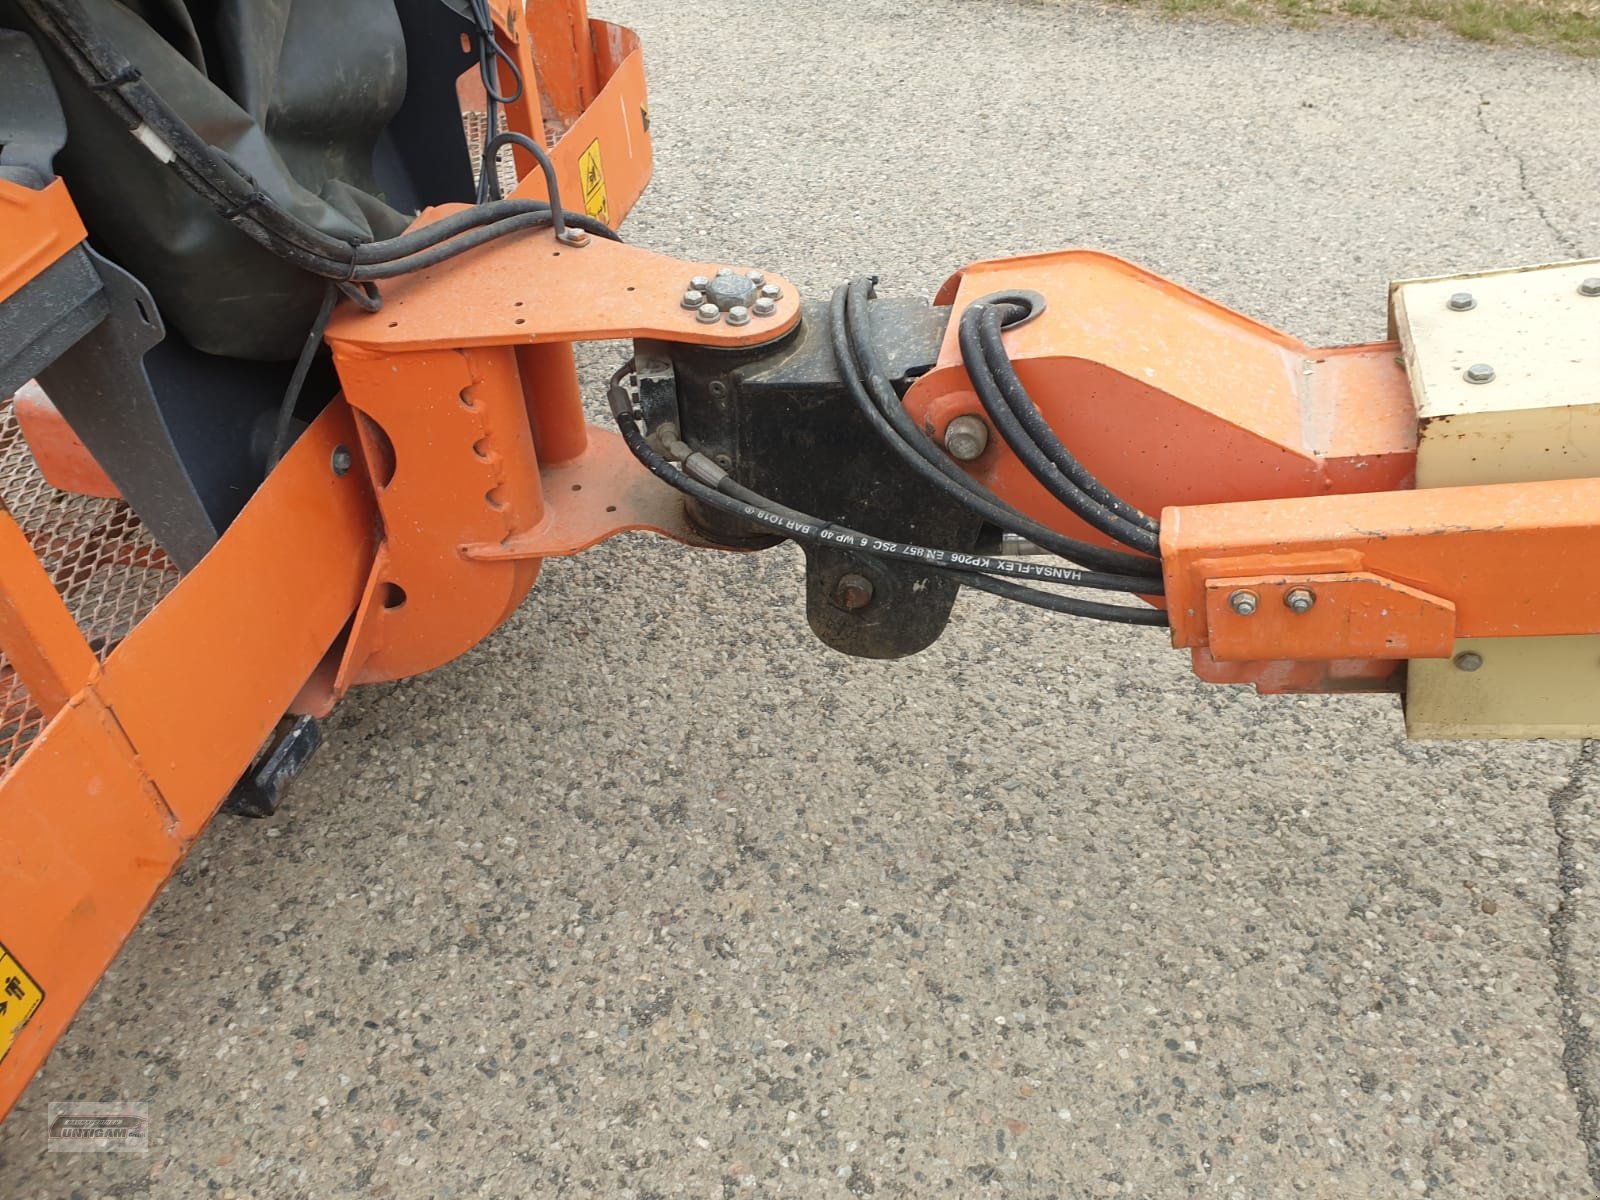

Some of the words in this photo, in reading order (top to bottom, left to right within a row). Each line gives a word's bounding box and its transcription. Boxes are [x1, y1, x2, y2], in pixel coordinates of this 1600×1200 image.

[785, 520, 811, 534] BAR
[820, 529, 834, 540] 40
[836, 534, 854, 545] WP
[860, 537, 868, 547] 6
[872, 540, 898, 552] 2SC
[902, 546, 925, 557] 857
[926, 549, 945, 560] EN
[951, 553, 990, 568] KP206
[996, 560, 1081, 580] HANSA-FLEX
